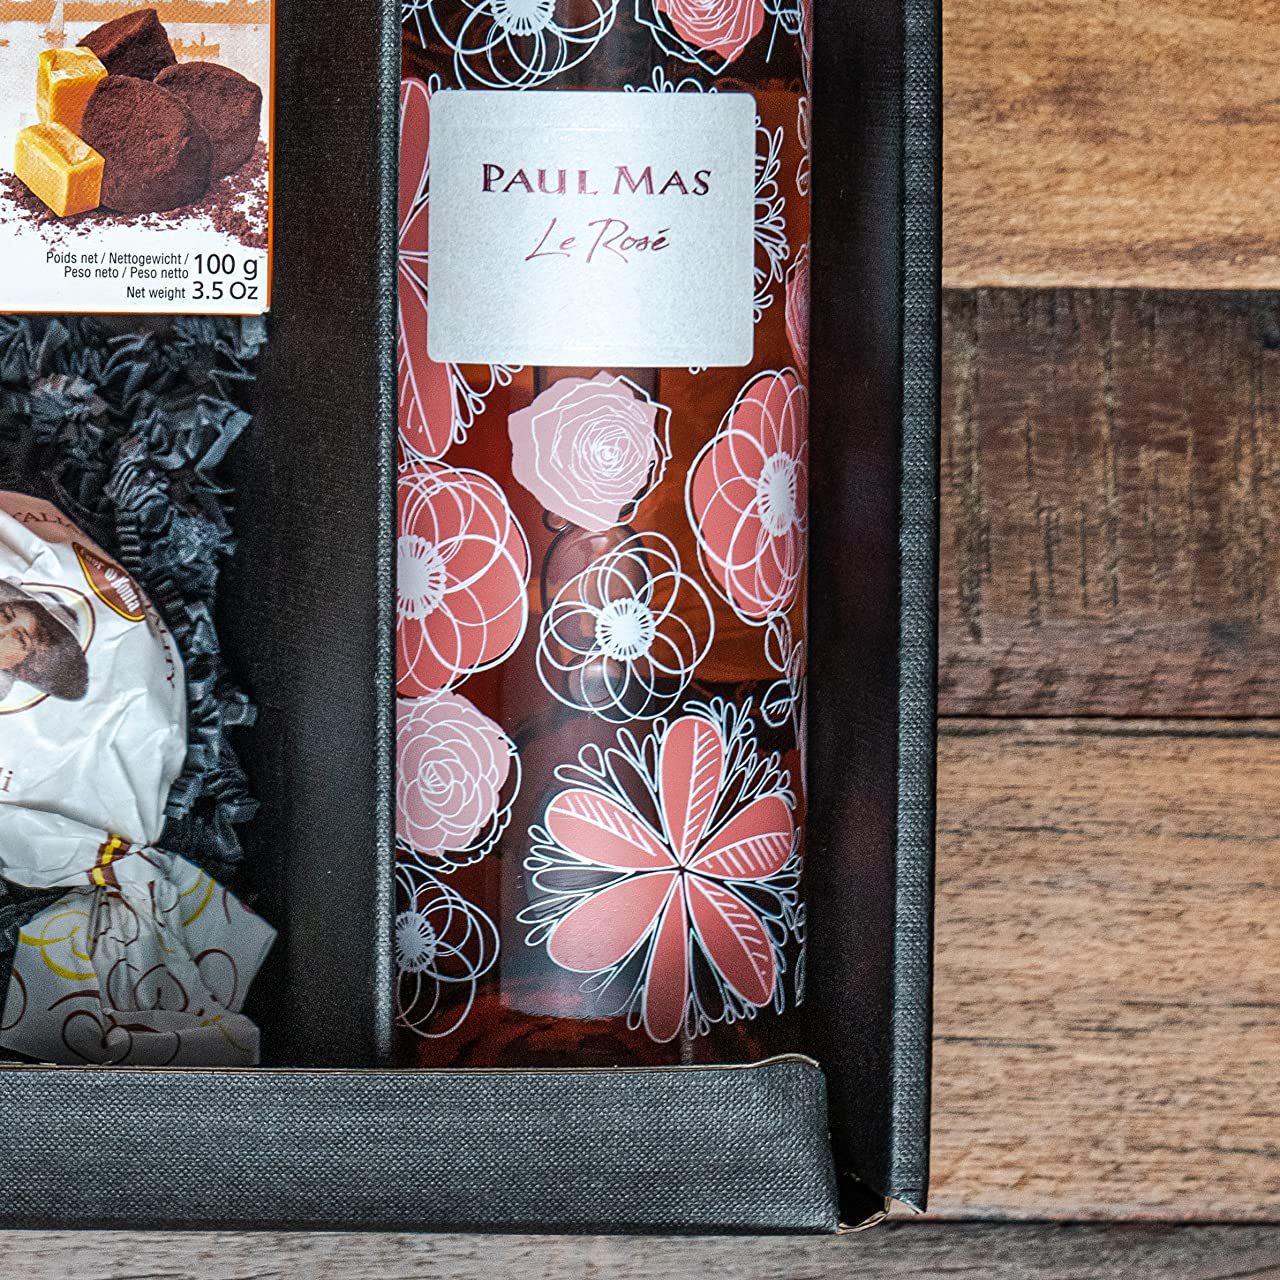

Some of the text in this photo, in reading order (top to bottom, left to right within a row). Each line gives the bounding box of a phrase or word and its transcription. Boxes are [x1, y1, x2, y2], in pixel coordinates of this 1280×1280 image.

[481, 163, 712, 195] PAUL MAS
[525, 217, 671, 263] Le Rosé
[46, 252, 77, 264] Poids
[81, 252, 98, 264] net
[109, 252, 182, 267] Nettogewicht
[194, 253, 259, 280] 100 g
[64, 266, 91, 278] Peso
[95, 268, 119, 278] neto
[130, 267, 157, 279] Peso
[161, 268, 189, 279] netto
[126, 281, 258, 300] Net weight 3.5 Oz
